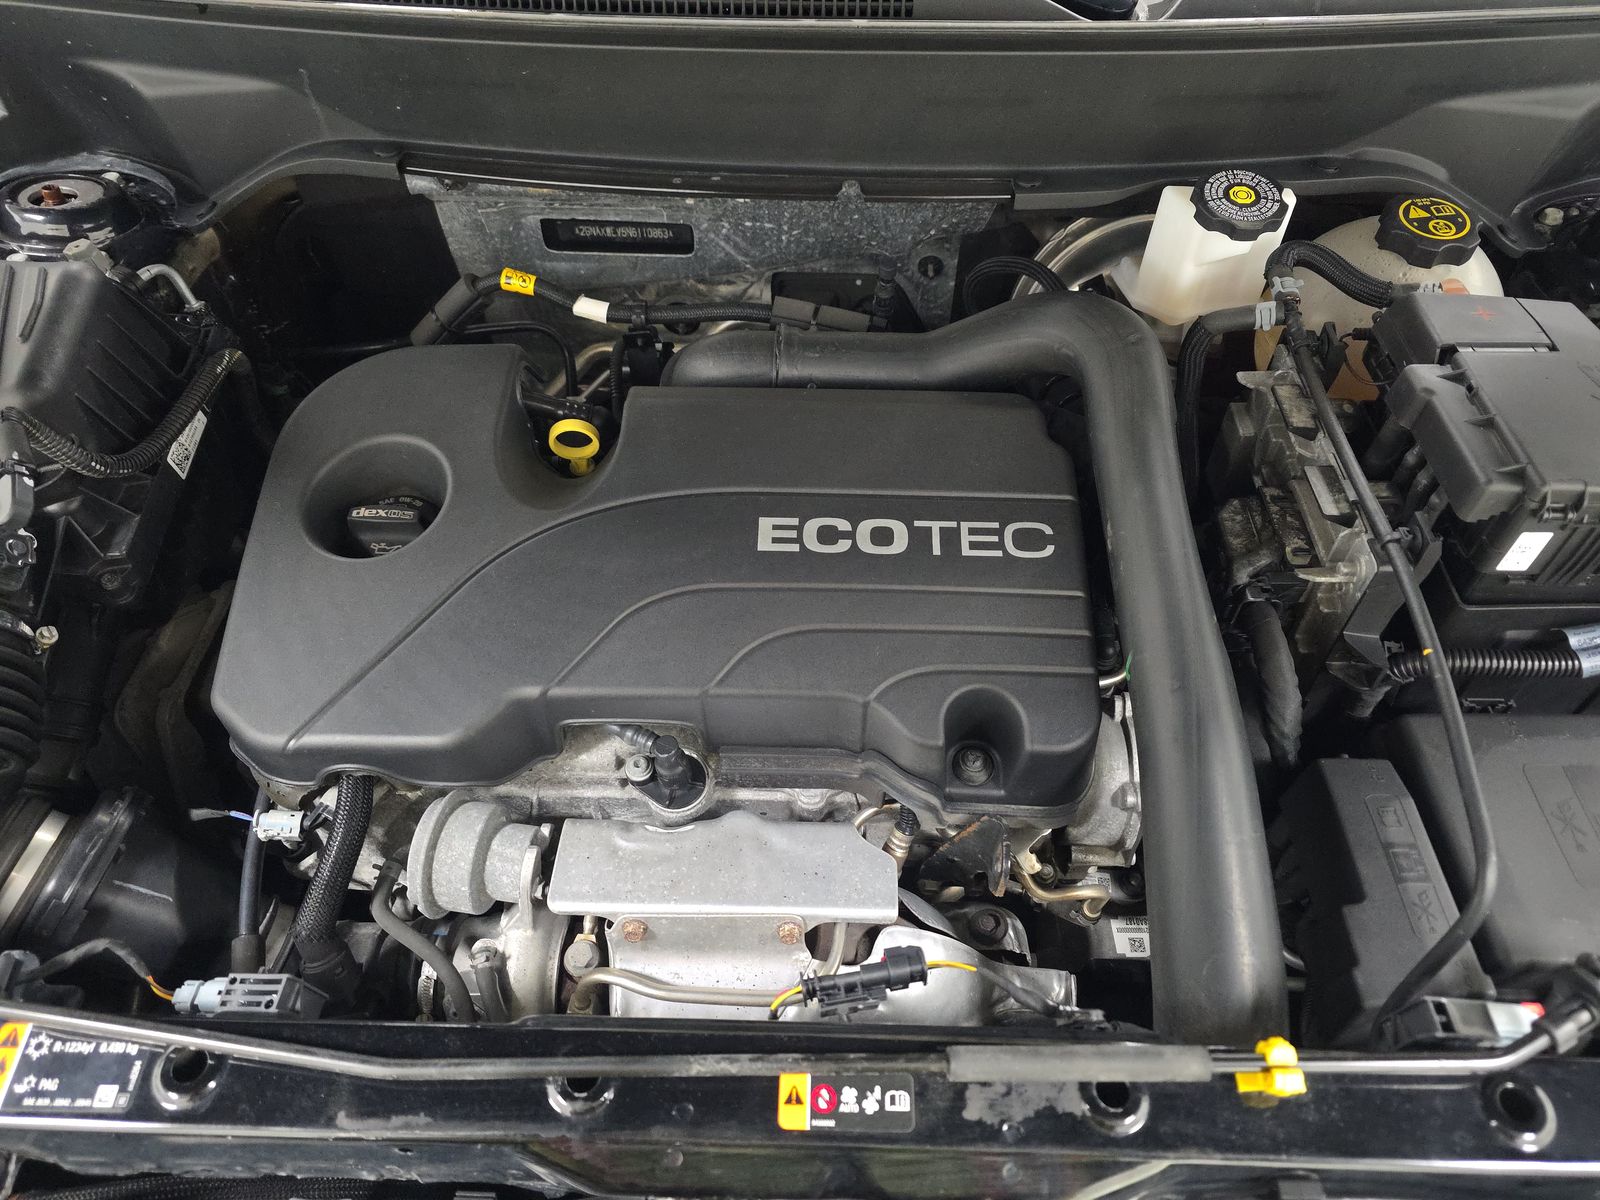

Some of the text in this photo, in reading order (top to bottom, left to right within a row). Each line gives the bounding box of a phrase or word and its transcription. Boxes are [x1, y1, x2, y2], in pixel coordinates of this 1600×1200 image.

[351, 508, 414, 519] dexos
[757, 517, 1056, 559] ECOTEC
[38, 1078, 59, 1090] PAG
[838, 1103, 860, 1113] AUTO
